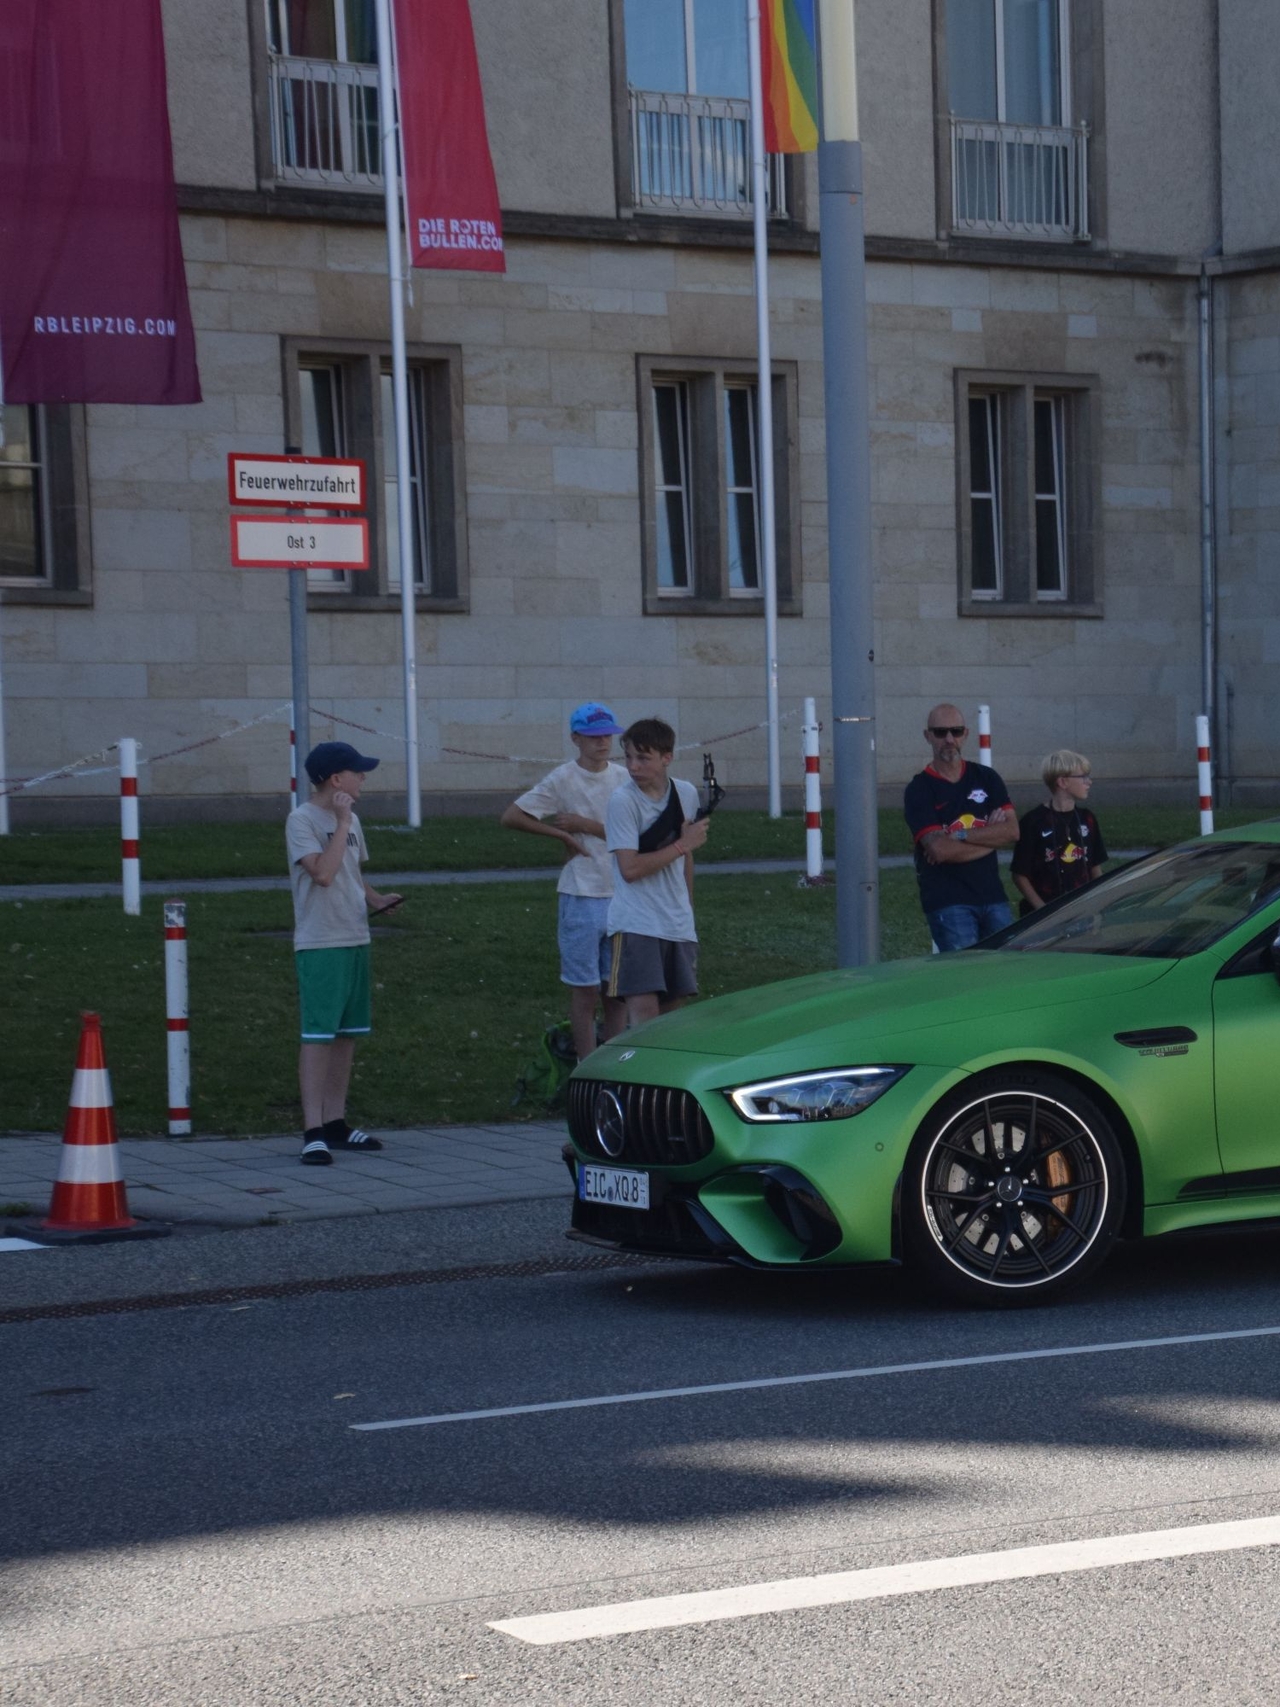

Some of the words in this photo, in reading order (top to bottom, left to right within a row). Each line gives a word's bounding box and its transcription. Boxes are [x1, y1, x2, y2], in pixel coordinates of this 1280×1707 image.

[418, 218, 445, 233] DIE
[449, 218, 496, 236] ROTEN
[239, 471, 356, 493] Feuerwehrzufahrt
[287, 535, 304, 549] Ost
[309, 536, 316, 549] 3
[586, 1171, 607, 1199] EIC
